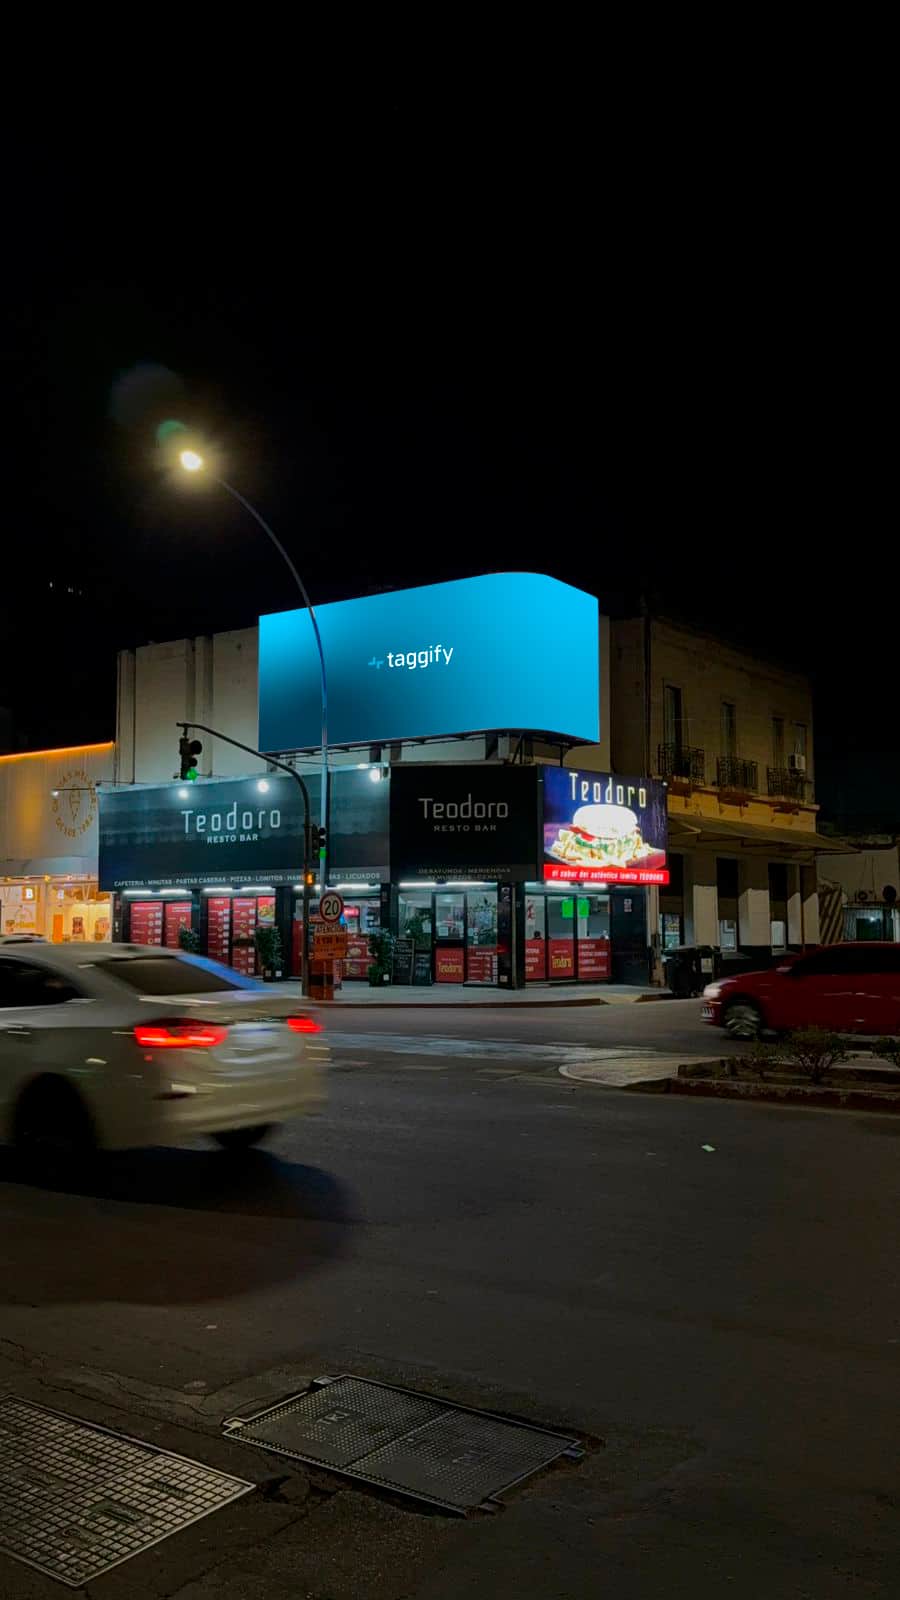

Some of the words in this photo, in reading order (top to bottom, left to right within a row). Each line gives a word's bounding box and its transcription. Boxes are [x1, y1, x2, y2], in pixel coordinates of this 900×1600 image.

[386, 644, 454, 670] taggify
[569, 771, 648, 808] Teodoro
[181, 801, 282, 834] Teodoro
[417, 793, 509, 820] Teodoro
[206, 833, 237, 844] RESTO
[239, 832, 259, 842] BAR
[433, 824, 471, 832] RESTO
[474, 823, 497, 832] BAR
[324, 900, 340, 916] 20
